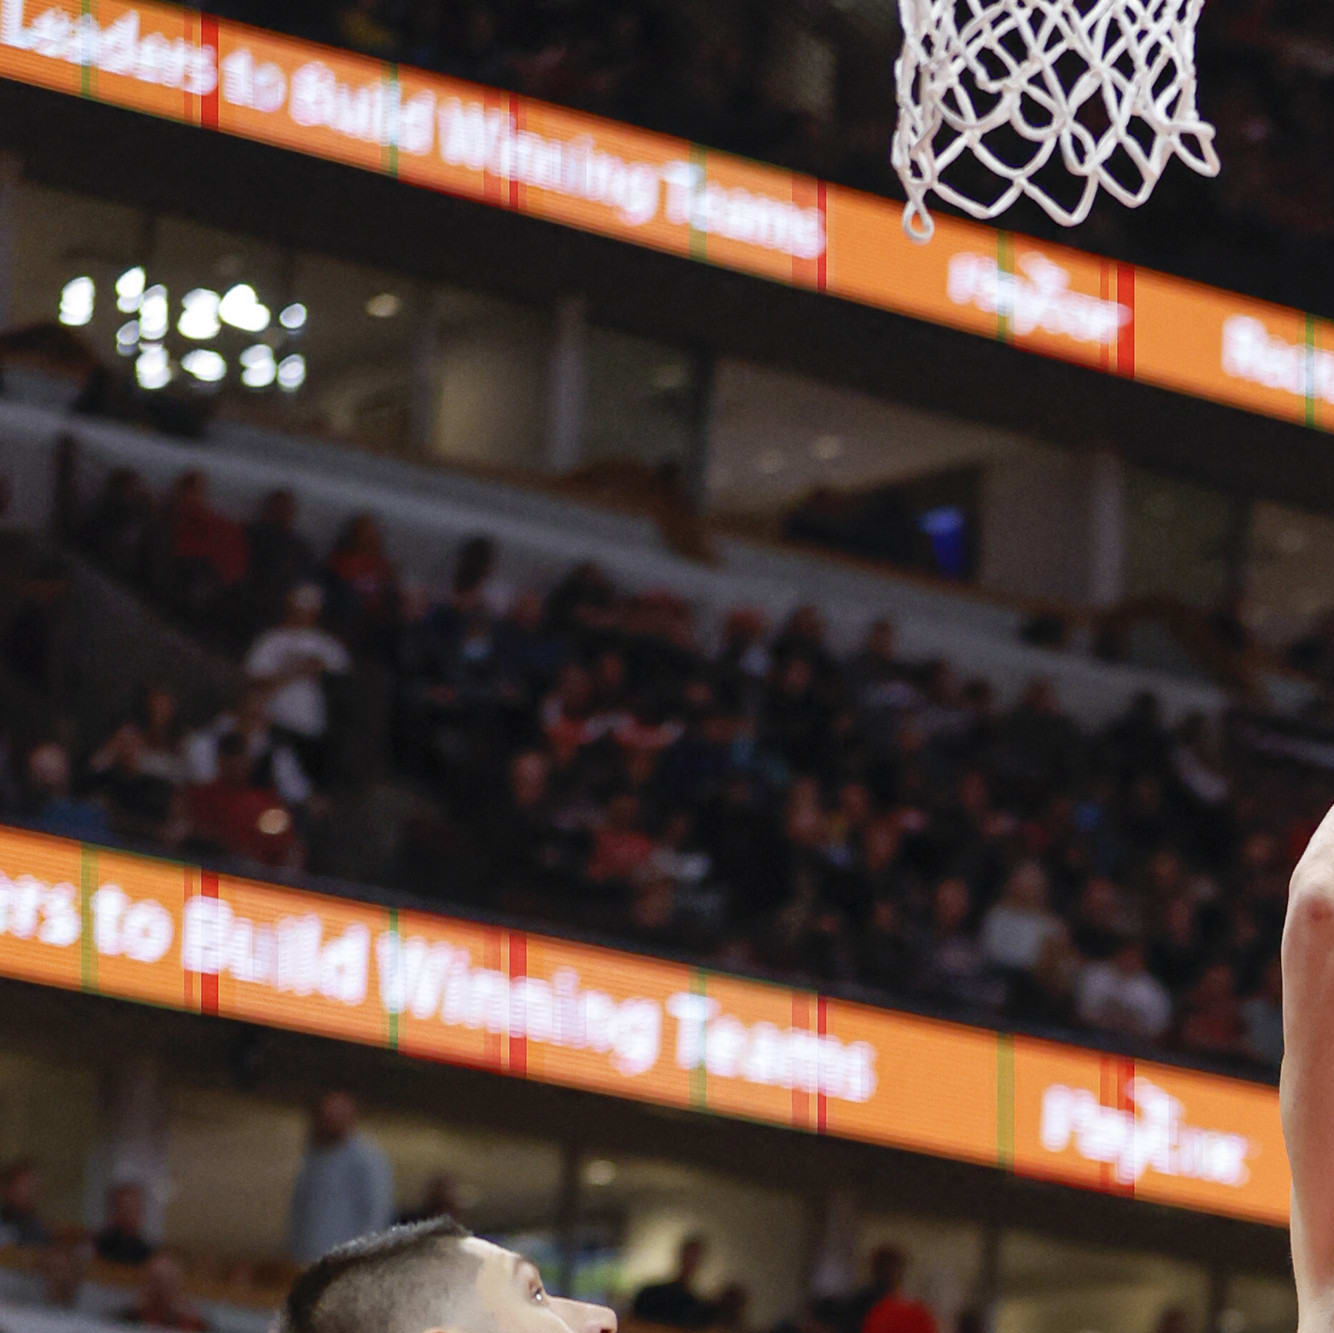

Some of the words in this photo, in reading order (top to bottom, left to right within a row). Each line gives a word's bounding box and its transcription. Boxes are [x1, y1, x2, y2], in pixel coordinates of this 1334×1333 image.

[221, 48, 286, 113] to
[289, 60, 436, 156] Build
[437, 97, 659, 226] Winning
[659, 161, 826, 260] Teams
[91, 884, 173, 963] to
[181, 894, 370, 1006] Build
[376, 930, 662, 1076] Winning
[667, 991, 877, 1103] Teams
